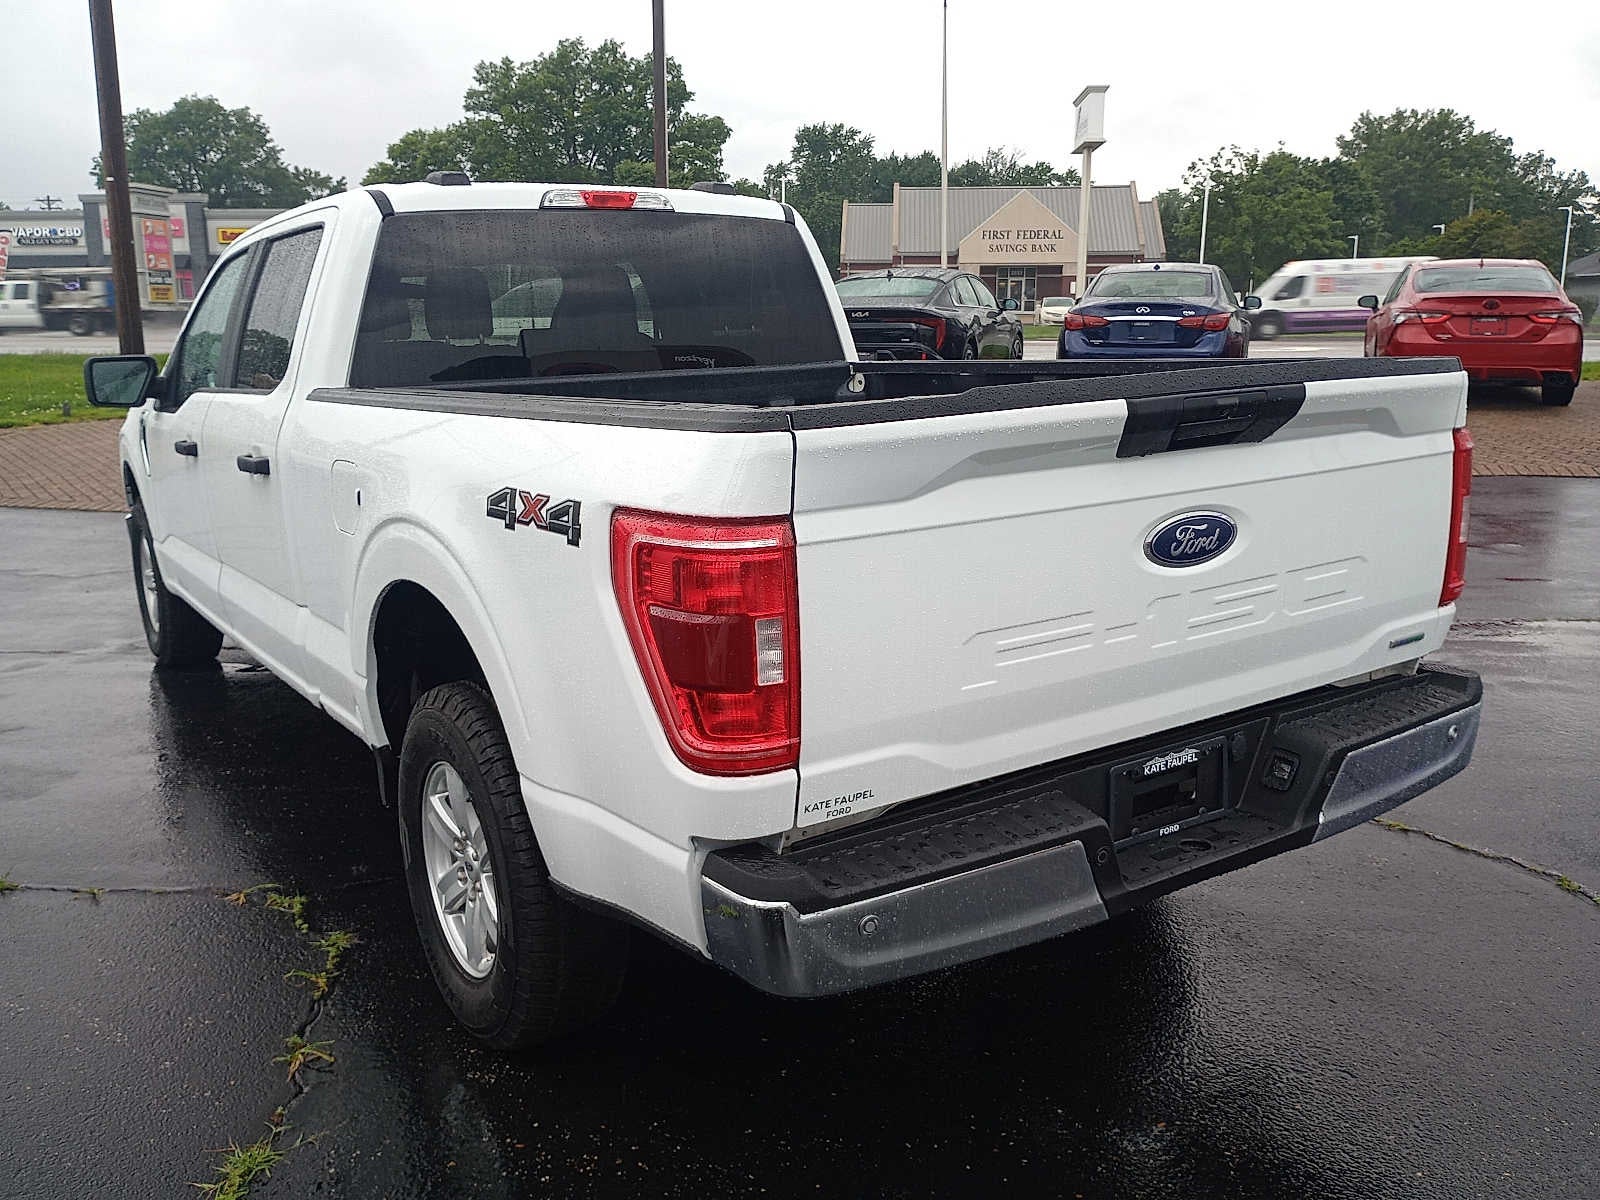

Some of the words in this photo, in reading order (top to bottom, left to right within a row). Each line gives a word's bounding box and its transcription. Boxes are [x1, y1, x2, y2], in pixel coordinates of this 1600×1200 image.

[11, 226, 50, 238] VAPOR
[58, 226, 82, 238] CBD
[982, 229, 1012, 240] FIRST
[1016, 229, 1064, 240] FEDERAL
[988, 243, 1028, 253] SAVINGS
[1031, 243, 1057, 253] BANK
[1170, 523, 1220, 557] Ford
[1144, 761, 1167, 776] KATE
[1167, 752, 1199, 769] FAUPEL
[804, 800, 833, 814] KATE
[834, 789, 875, 807] FAUPEL
[826, 806, 852, 819] FORD
[1159, 824, 1180, 837] FORD
